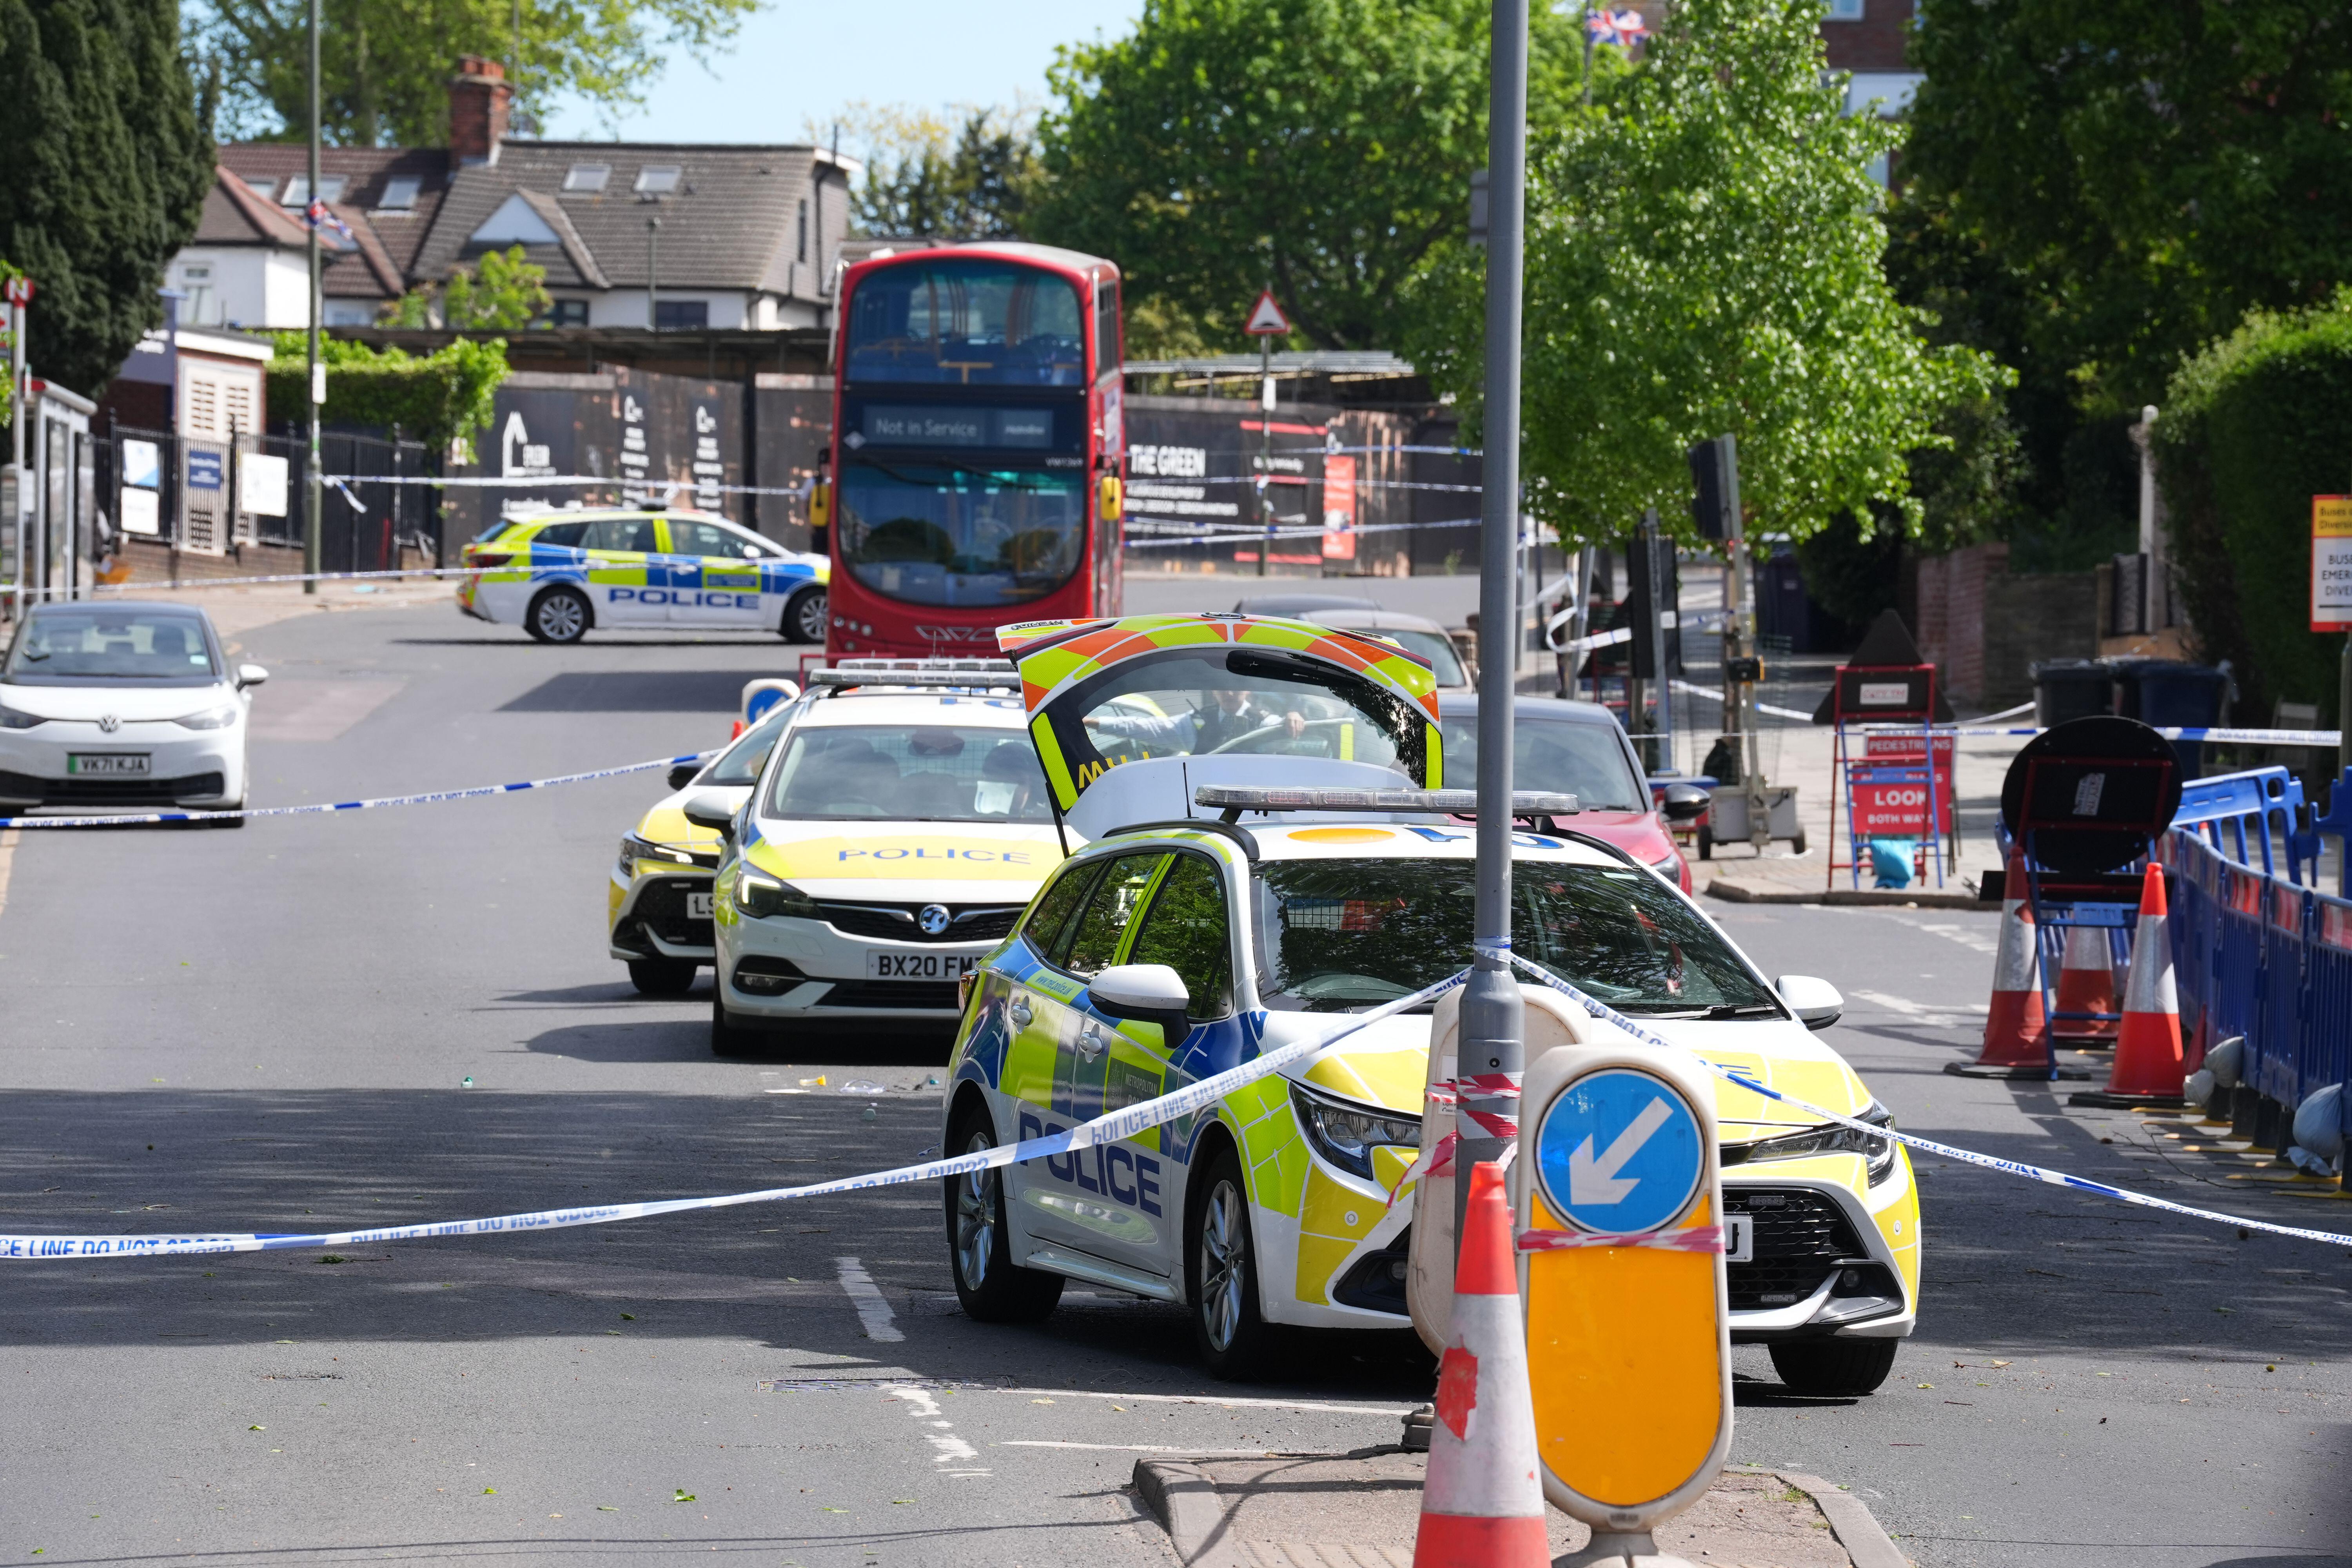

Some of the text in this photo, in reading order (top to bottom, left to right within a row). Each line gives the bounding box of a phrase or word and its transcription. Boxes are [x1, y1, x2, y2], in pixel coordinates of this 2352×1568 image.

[876, 418, 977, 437] Not in Service
[1129, 444, 1206, 477] THE GREEN
[2321, 507, 2346, 516] Buses
[2322, 570, 2352, 580] EMER
[609, 588, 759, 610] POLICE
[1869, 739, 1952, 751] PEDESTRINS
[118, 758, 144, 771] KJA
[1874, 790, 1927, 806] LOOK
[1867, 815, 1900, 824] BOTH
[838, 848, 1031, 865] POLICE
[878, 955, 983, 976] BX20 FM
[1125, 1073, 1158, 1096] METROPOLITAN
[1020, 1110, 1162, 1219] POLICE
[29, 1240, 76, 1257] LINE
[82, 1240, 110, 1255] DO
